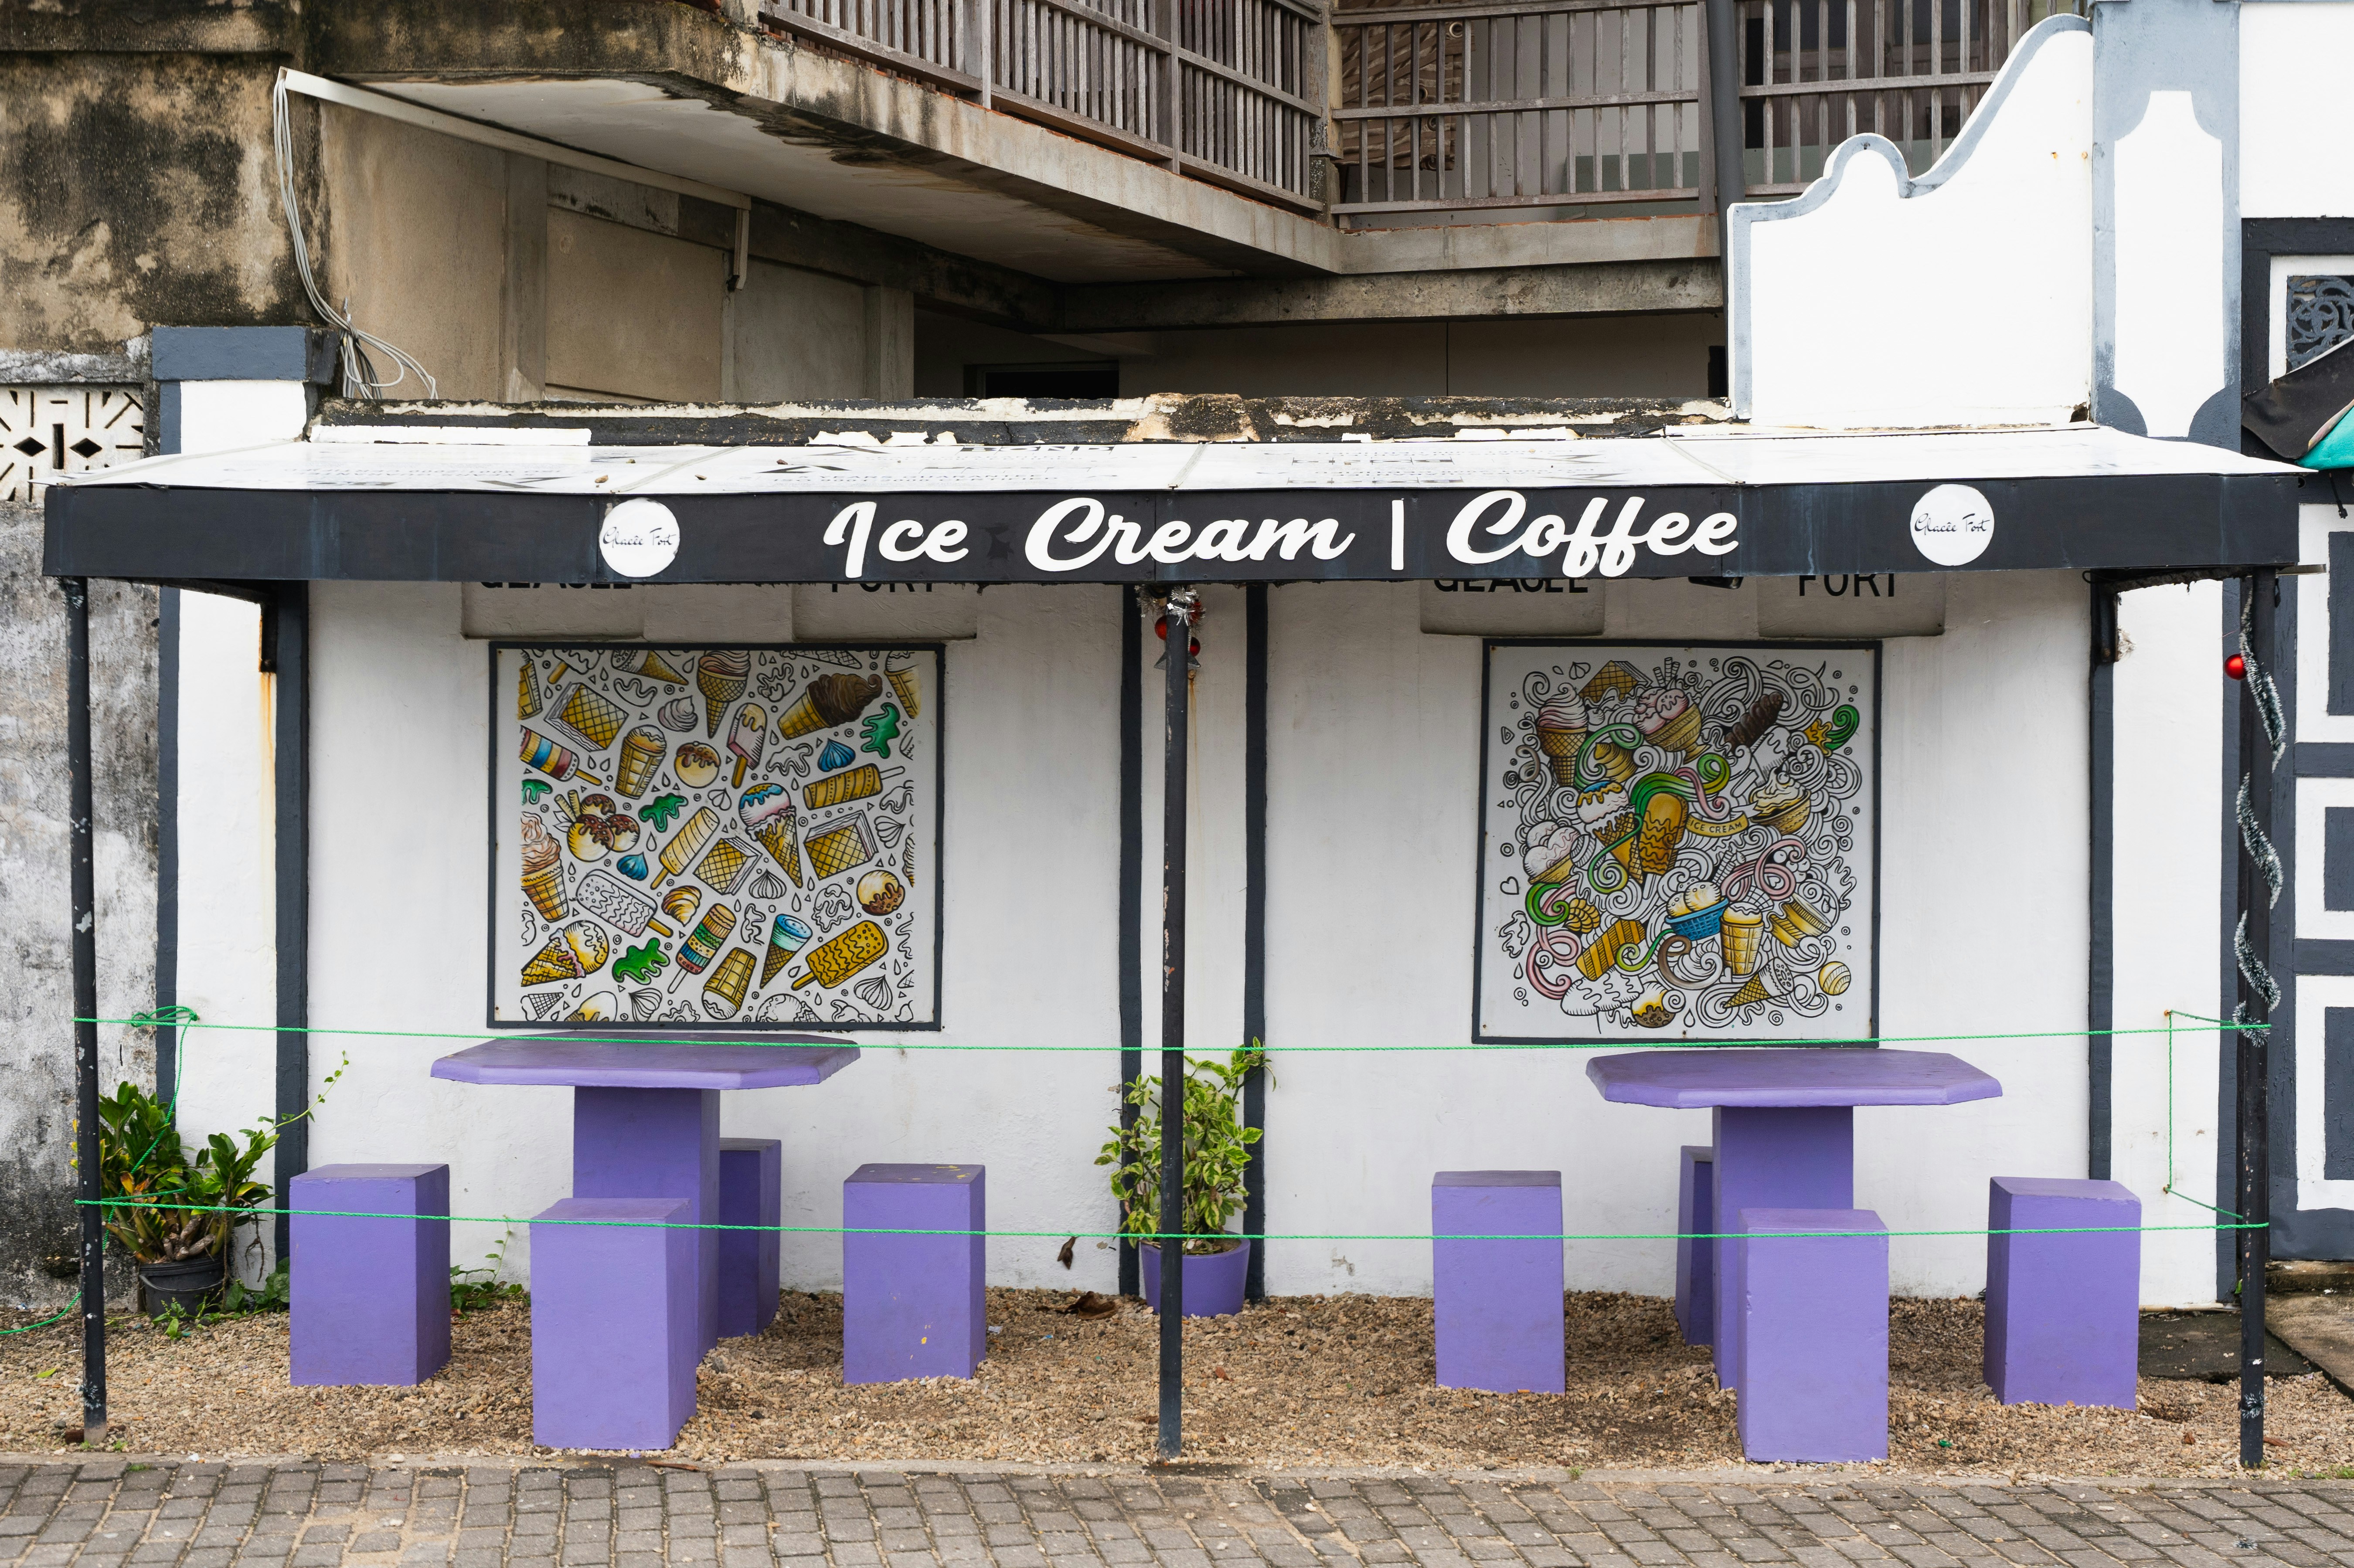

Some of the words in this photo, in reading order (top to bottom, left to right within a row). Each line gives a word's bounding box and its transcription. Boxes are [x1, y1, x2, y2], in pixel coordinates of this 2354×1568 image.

[1962, 513, 1991, 532] Fort
[823, 502, 968, 578] Ice
[1025, 498, 1355, 571] Cream
[1447, 490, 1738, 578] Coffee
[1690, 820, 1705, 831] ICE
[1709, 822, 1742, 834] CREAM
